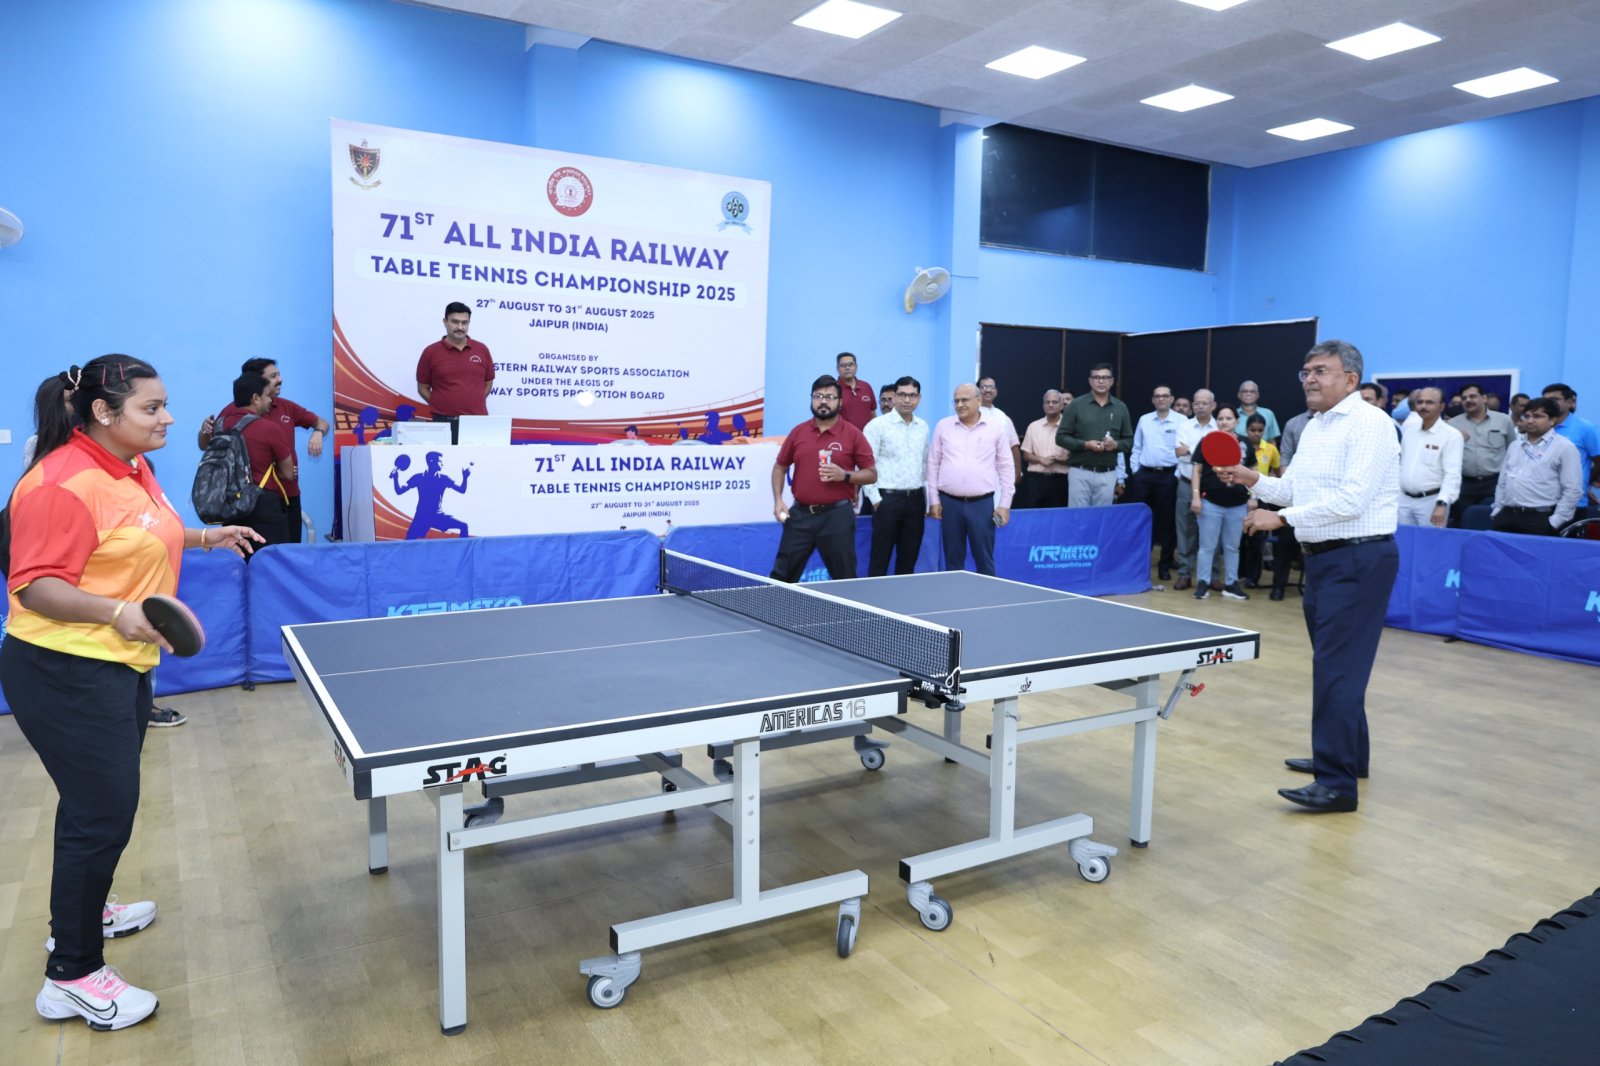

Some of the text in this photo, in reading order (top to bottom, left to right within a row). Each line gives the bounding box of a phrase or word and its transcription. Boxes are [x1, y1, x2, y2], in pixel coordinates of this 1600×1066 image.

[443, 221, 502, 249] ALL
[511, 228, 602, 259] INDIA
[611, 238, 729, 270] RAILWAY
[371, 255, 736, 301] TABLE TENNIS CHAMPIONSHIP 2025
[499, 300, 545, 313] AUGUST
[548, 303, 563, 313] TO
[585, 306, 628, 318] AUGUST
[630, 310, 655, 320] 2025
[529, 318, 609, 333] JAIPUR (INDIA)
[538, 352, 599, 362] ORGANISED BY
[493, 362, 690, 378] STERN RAILWAY SPORTS ASSOCIATION
[521, 377, 615, 387] UNDER THE AEGIS OF
[516, 387, 560, 397] SPORTS
[562, 389, 627, 399] PROTION
[630, 391, 665, 400] BOARD
[571, 456, 605, 472] ALL
[610, 456, 665, 471] INDIA
[671, 456, 746, 470] RAILWAY
[530, 479, 751, 494] TABLE TENNIS CHAMPIONSHIP 2025
[604, 501, 632, 509] AUGUST
[684, 499, 700, 507] 2025
[648, 510, 671, 518] (INDIA)
[1196, 648, 1233, 664] STAG
[759, 699, 866, 733] AMERICAS 16
[422, 756, 508, 785] STAG
